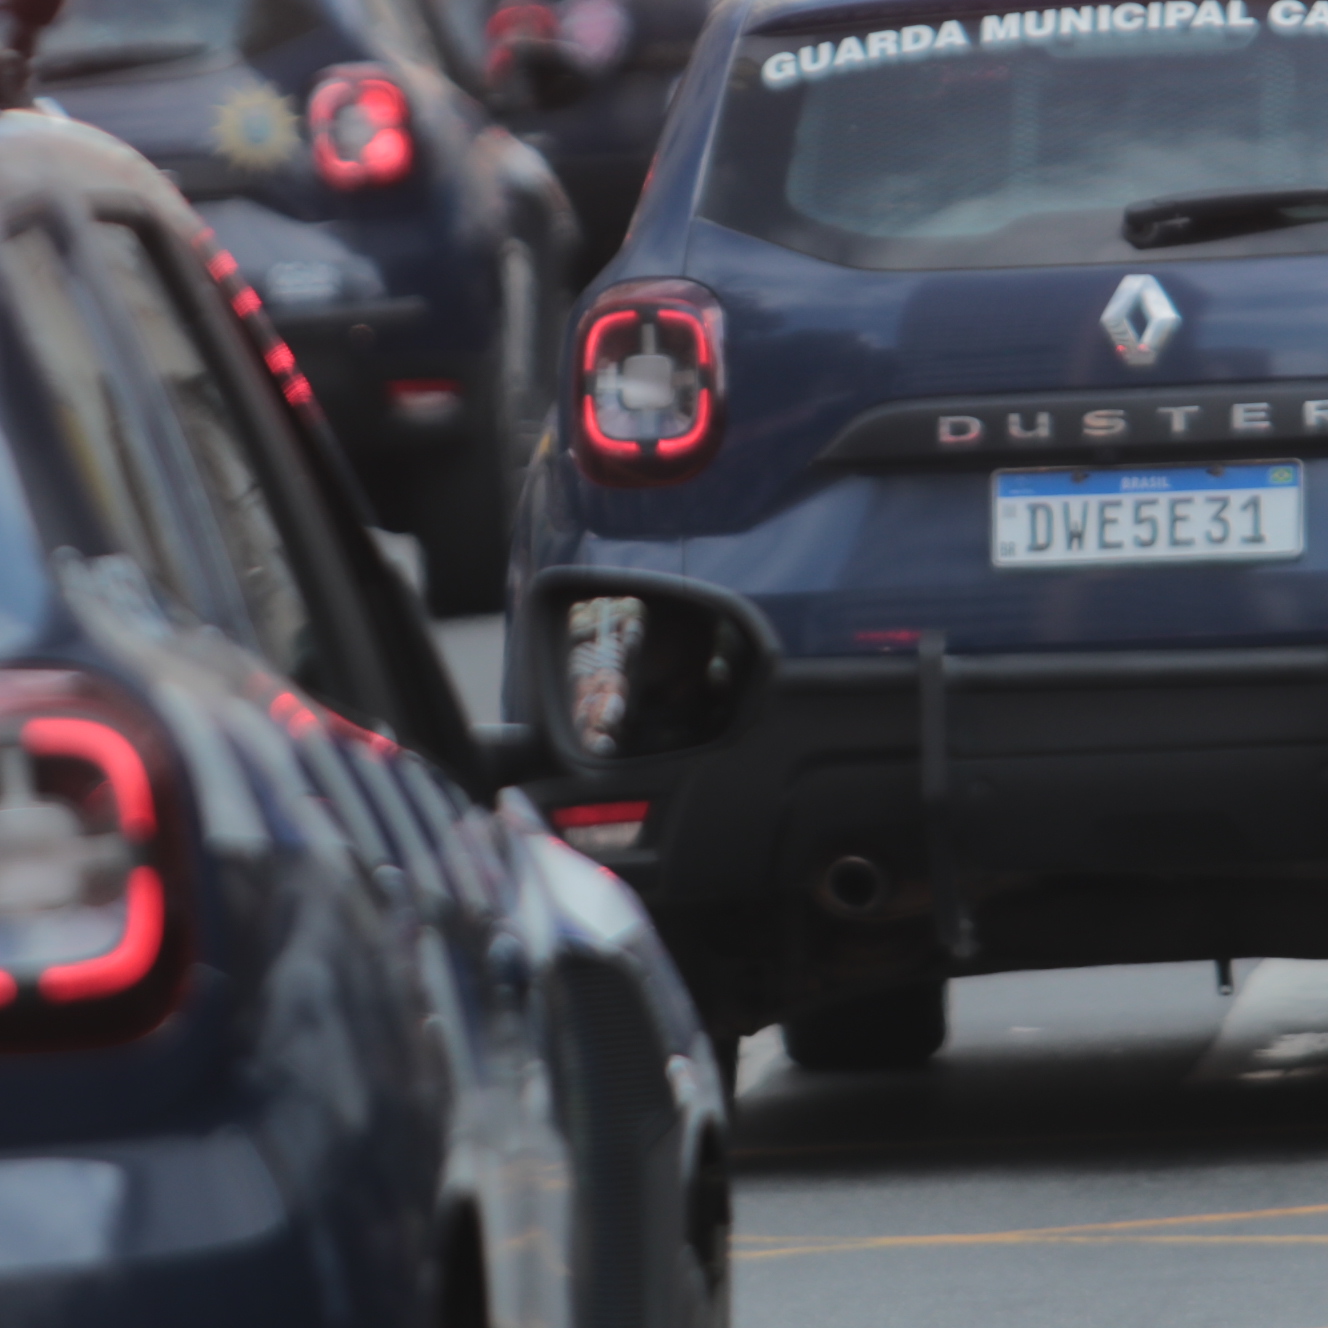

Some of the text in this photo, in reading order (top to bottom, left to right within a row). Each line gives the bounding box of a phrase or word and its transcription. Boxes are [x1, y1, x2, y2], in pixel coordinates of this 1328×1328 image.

[761, 19, 969, 89] GUARDA
[979, 0, 1257, 46] MUNICIPAL
[1026, 495, 1268, 552] DWE5E31
